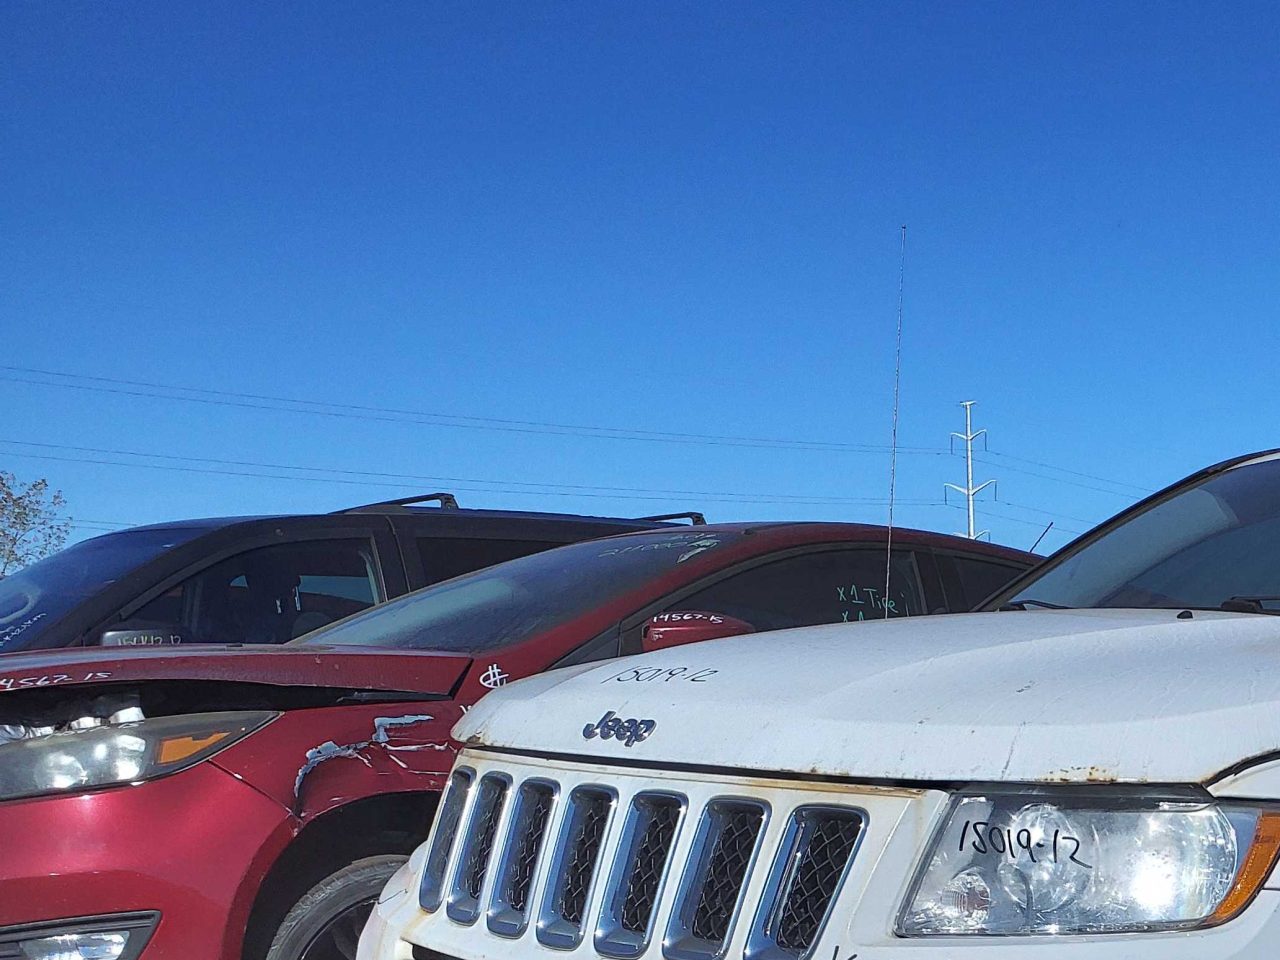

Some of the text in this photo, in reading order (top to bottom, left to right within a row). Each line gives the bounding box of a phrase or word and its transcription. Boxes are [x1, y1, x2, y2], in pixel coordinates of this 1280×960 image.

[653, 613, 724, 624] 14567-15
[600, 666, 719, 684] 15019-12
[582, 711, 657, 747] Jeep
[959, 820, 1093, 868] 15019-12
